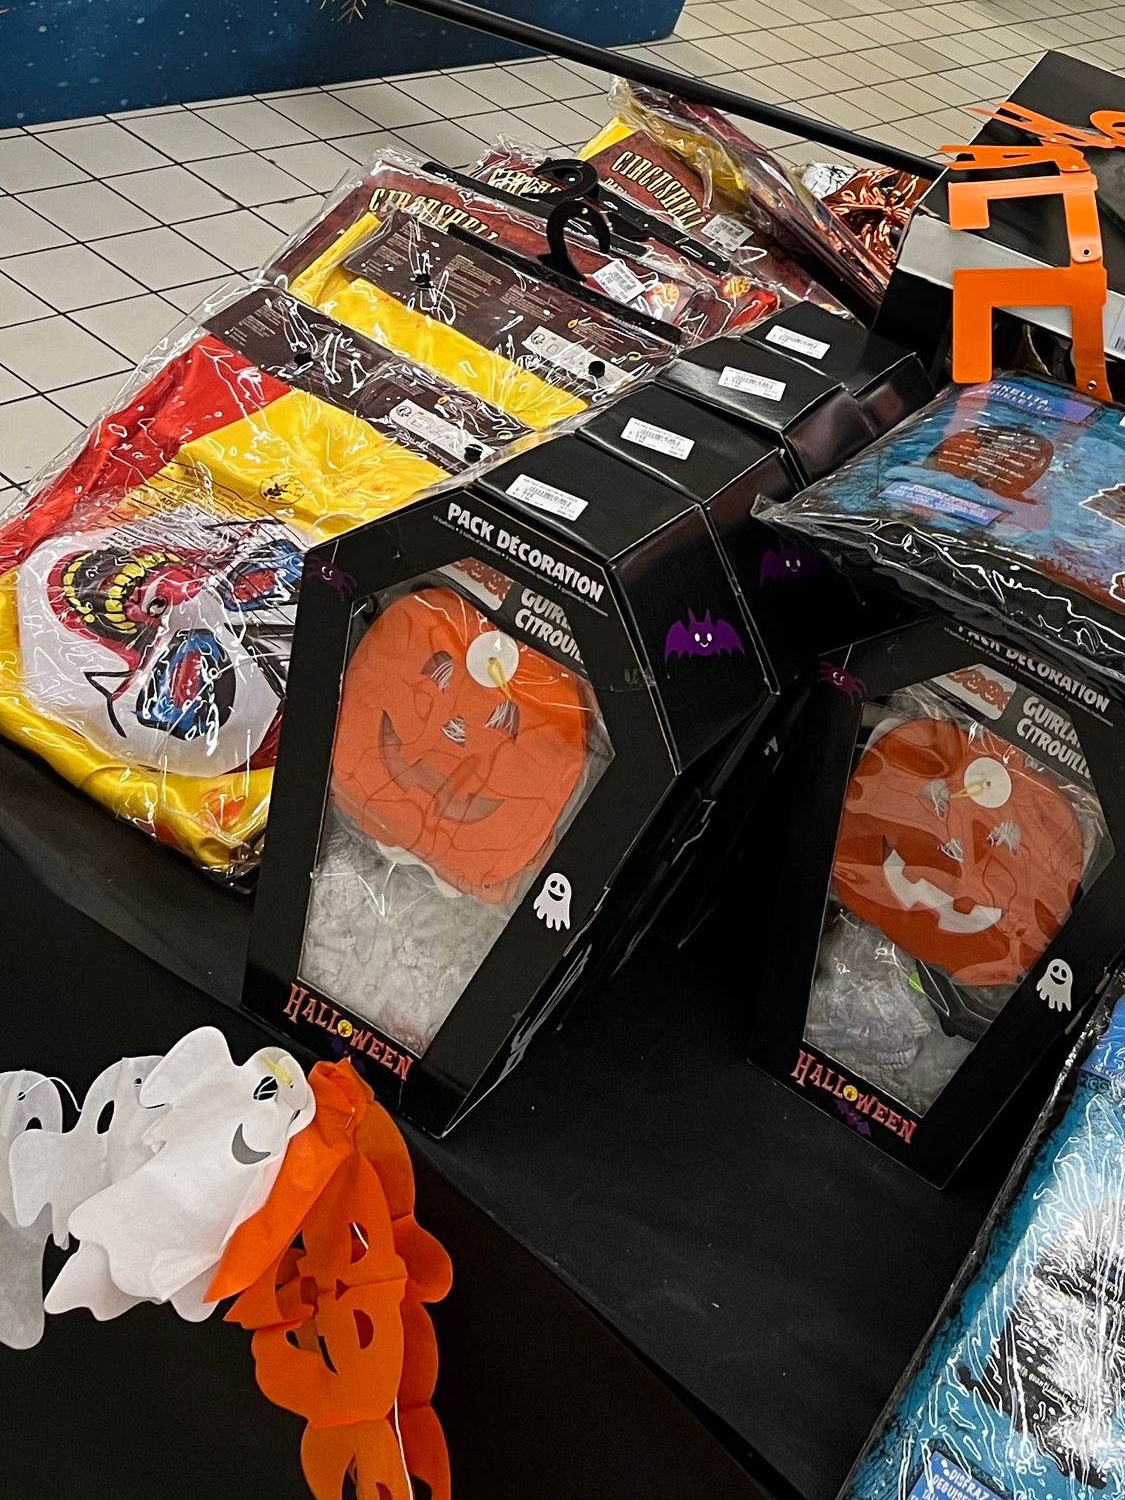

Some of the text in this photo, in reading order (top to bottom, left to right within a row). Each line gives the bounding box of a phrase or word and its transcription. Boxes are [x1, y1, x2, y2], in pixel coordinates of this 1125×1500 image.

[447, 502, 604, 602] PACK DÉCORATION
[1022, 696, 1080, 748] GUIRLA
[282, 982, 414, 1082] HALLOWEEN
[790, 1048, 918, 1144] HALLOWEEN
